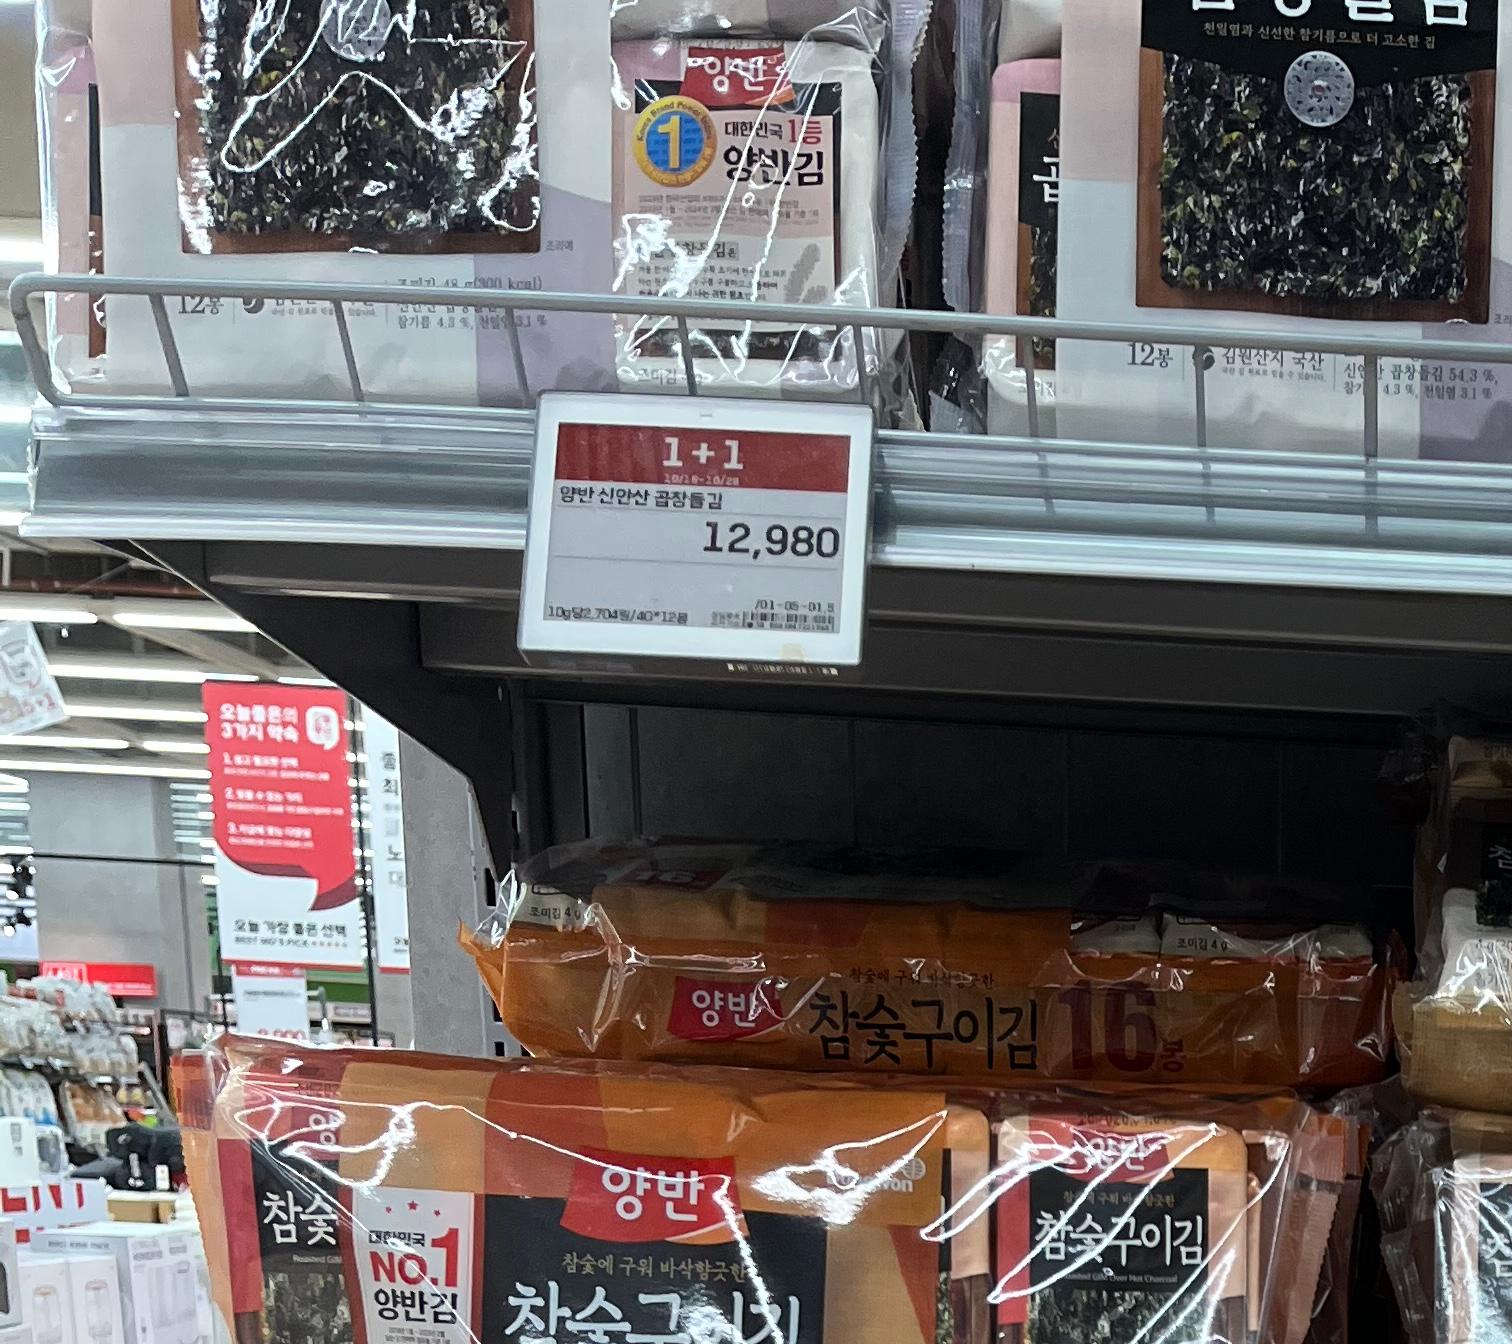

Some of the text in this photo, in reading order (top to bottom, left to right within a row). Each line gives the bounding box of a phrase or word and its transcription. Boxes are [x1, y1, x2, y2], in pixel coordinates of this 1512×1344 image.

[1203, 22, 1435, 48] 천일염과 신선한 참기름으로 더 고소한 김
[725, 119, 823, 144] 대한민국 1등
[1128, 341, 1172, 368] 12봉
[663, 437, 744, 470] 1+1
[560, 486, 723, 509] 양반 신안산 곱창돌김
[703, 522, 840, 560] 12,980
